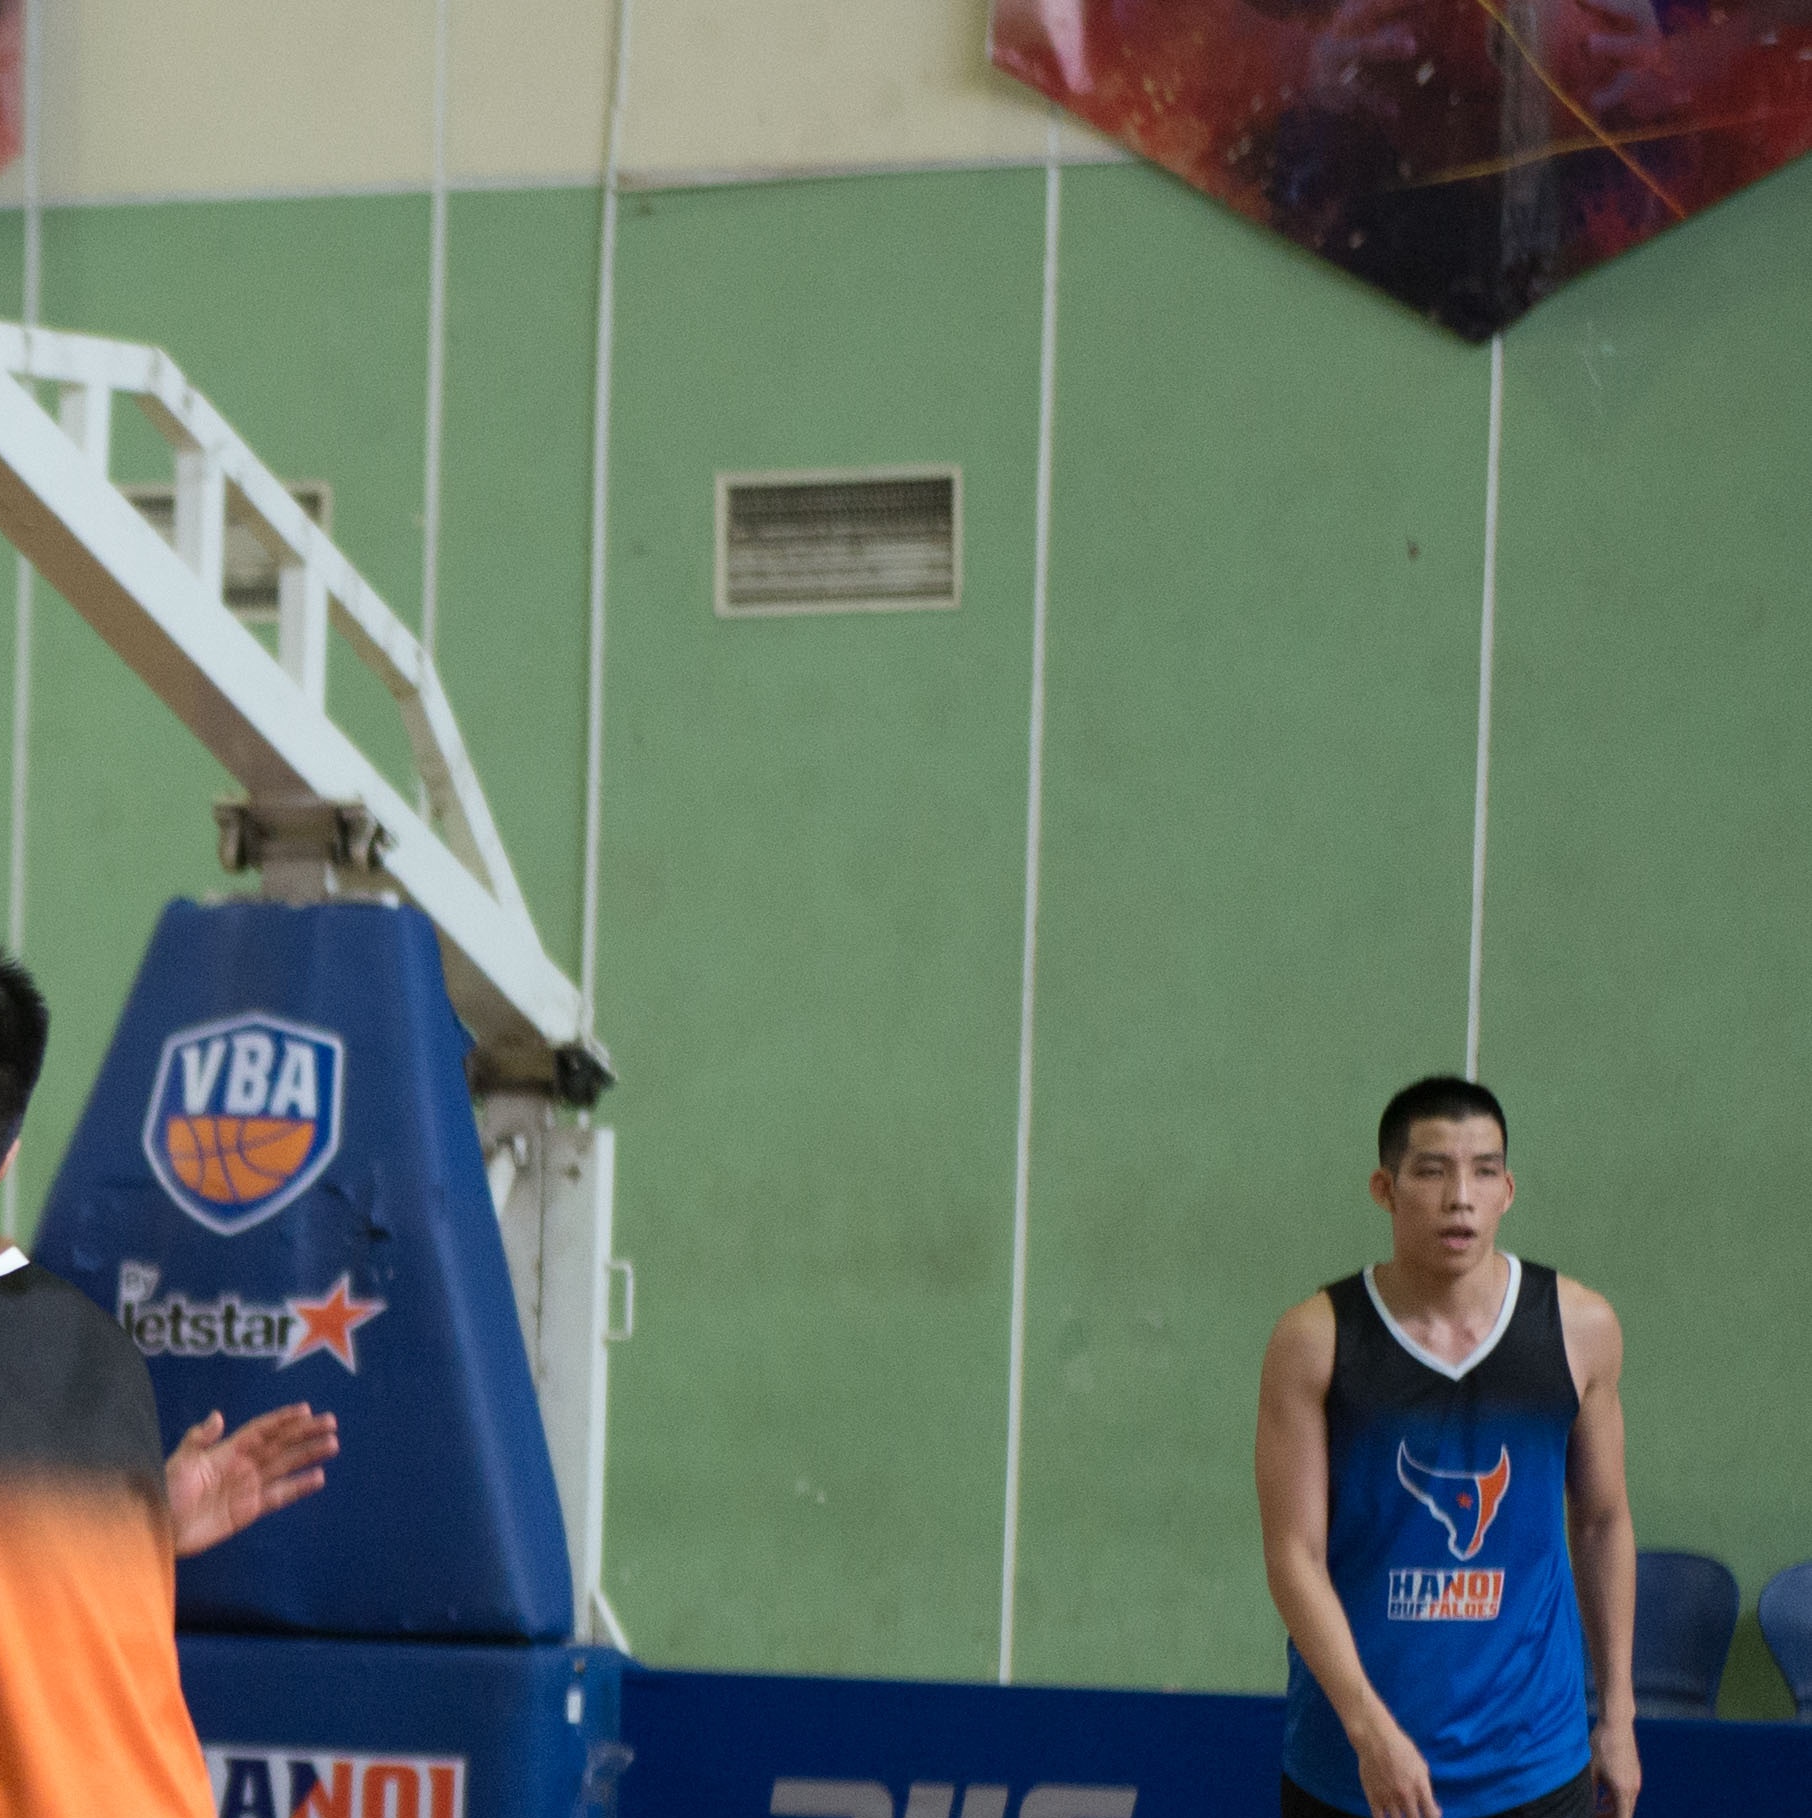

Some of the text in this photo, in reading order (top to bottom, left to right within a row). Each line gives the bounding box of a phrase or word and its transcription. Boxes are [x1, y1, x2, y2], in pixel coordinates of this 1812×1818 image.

[182, 1032, 318, 1118] VBA
[1391, 1572, 1503, 1601] HANOI
[1390, 1601, 1498, 1619] BUFFALOES
